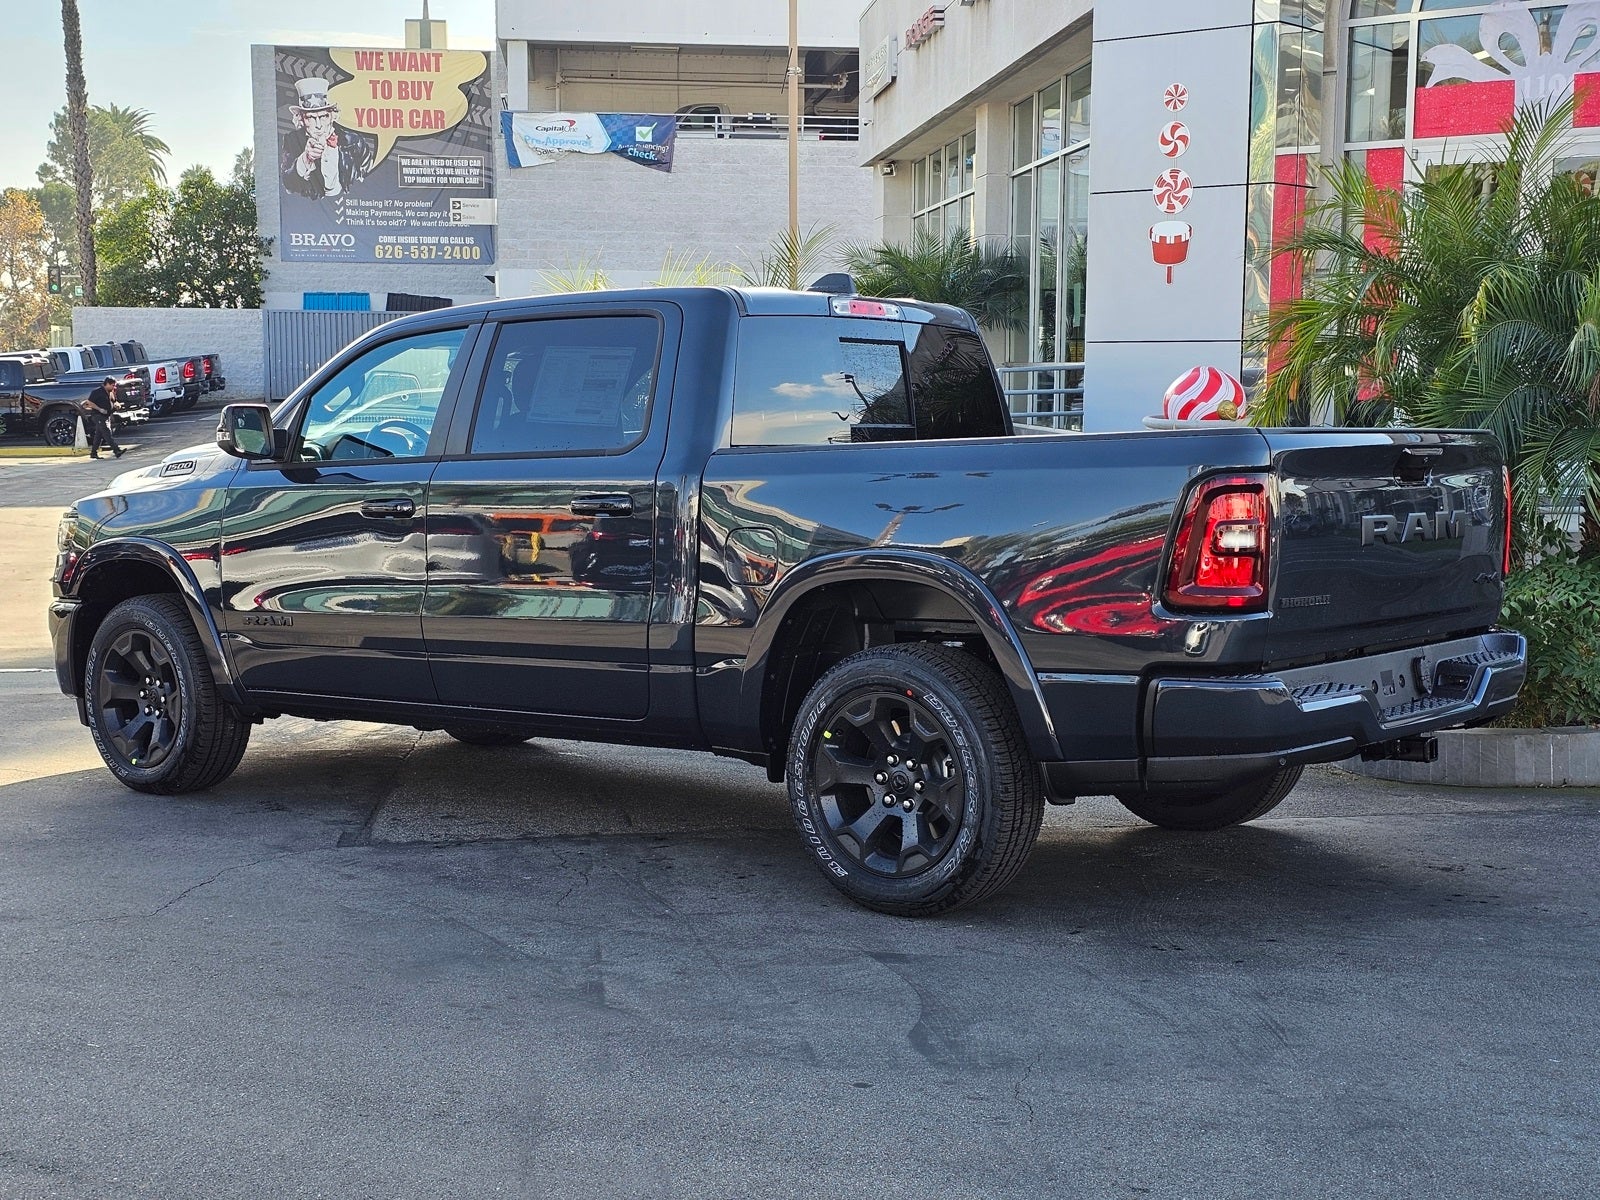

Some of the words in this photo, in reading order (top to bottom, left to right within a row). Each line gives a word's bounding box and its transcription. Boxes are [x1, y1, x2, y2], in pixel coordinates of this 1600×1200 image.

[355, 51, 384, 71] WE
[388, 52, 443, 73] WANT
[369, 80, 392, 100] TO
[398, 81, 434, 101] BUY
[354, 108, 404, 129] YOUR
[408, 109, 445, 129] CAR
[627, 147, 658, 161] Check.
[401, 158, 411, 166] WE
[453, 159, 469, 167] USED
[402, 167, 435, 175] INVENTORY,
[469, 168, 480, 176] PAY
[403, 176, 416, 184] TOP
[416, 176, 437, 184] MONEY
[437, 176, 448, 184] FOR
[449, 176, 464, 184] YOUR
[359, 199, 383, 208] leasing
[404, 200, 434, 209] problem!
[345, 209, 369, 218] Making
[370, 209, 404, 218] Payments,
[346, 218, 364, 226] Think
[290, 233, 356, 247] BRAVO
[379, 235, 397, 243] COME
[419, 236, 439, 244] TODAY
[440, 236, 449, 244] OR
[449, 236, 465, 244] CALL
[375, 244, 480, 260] 626-537-2400
[167, 461, 192, 471] 1500
[1361, 509, 1466, 547] RAM
[243, 615, 294, 627] RAM
[923, 692, 978, 815] DUELER
[793, 696, 849, 879] BRIDGESTONE
